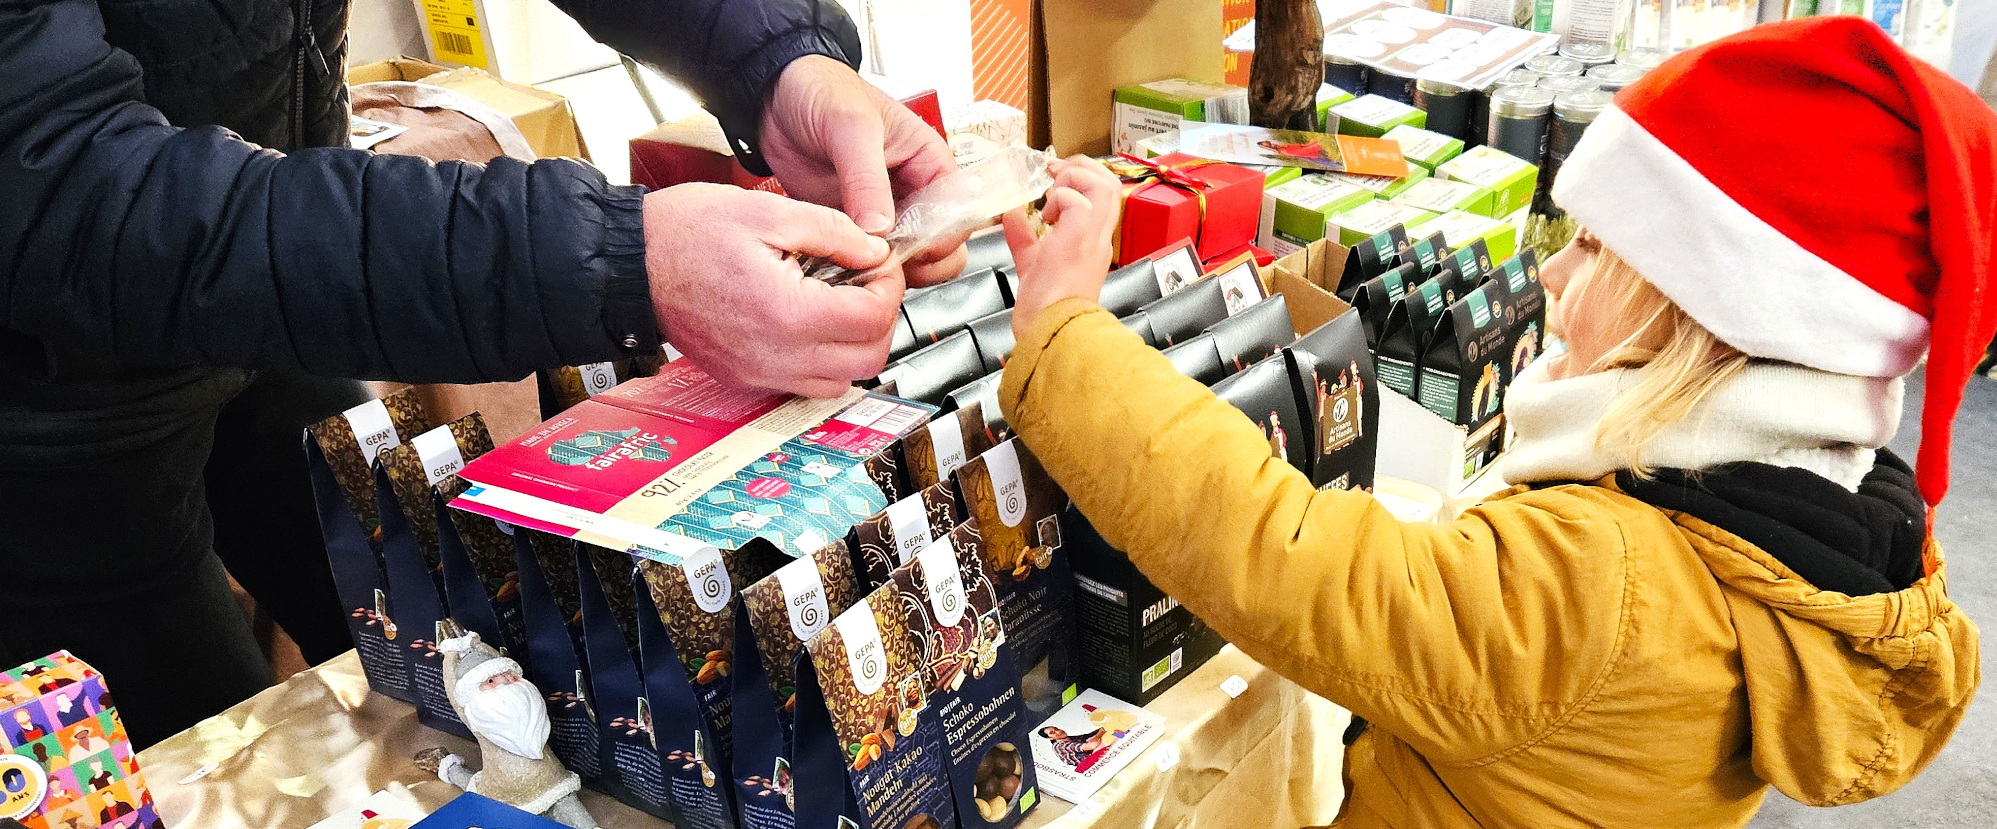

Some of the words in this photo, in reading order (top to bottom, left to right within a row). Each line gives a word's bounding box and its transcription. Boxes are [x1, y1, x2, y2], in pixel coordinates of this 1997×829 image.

[1480, 326, 1502, 344] Artisans
[1488, 336, 1505, 352] Monde
[520, 436, 540, 446] MADE
[549, 417, 574, 430] AFRICA
[1329, 435, 1335, 443] du
[1336, 426, 1353, 440] Monde
[1330, 420, 1352, 435] Artisans
[366, 431, 389, 446] GEPA
[584, 431, 658, 471] fairafric
[942, 453, 959, 467] GEPA
[433, 462, 458, 477] GEPA
[641, 478, 686, 497] 92%
[1000, 483, 1018, 496] GEPA
[903, 534, 924, 549] GEPA
[1035, 552, 1047, 565] fair
[693, 561, 717, 579] GEPA
[935, 578, 954, 594] GEPA
[1028, 586, 1048, 601] Noir
[793, 589, 817, 607] GEPA
[503, 608, 516, 619] FAIR
[855, 641, 875, 660] GEPA
[980, 650, 992, 664] fair
[704, 690, 717, 702] FAIR
[900, 716, 913, 730] fair
[943, 703, 974, 732] Schoko
[946, 687, 1015, 745] Espressobohnen
[951, 743, 966, 757] Choco
[953, 749, 971, 765] Graines
[1084, 748, 1120, 778] COMMERCE
[859, 774, 870, 789] FAIR
[863, 768, 894, 804] Nougat
[894, 746, 923, 773] Kakao
[12, 792, 30, 803] ANS
[866, 779, 903, 818] Mandeln
